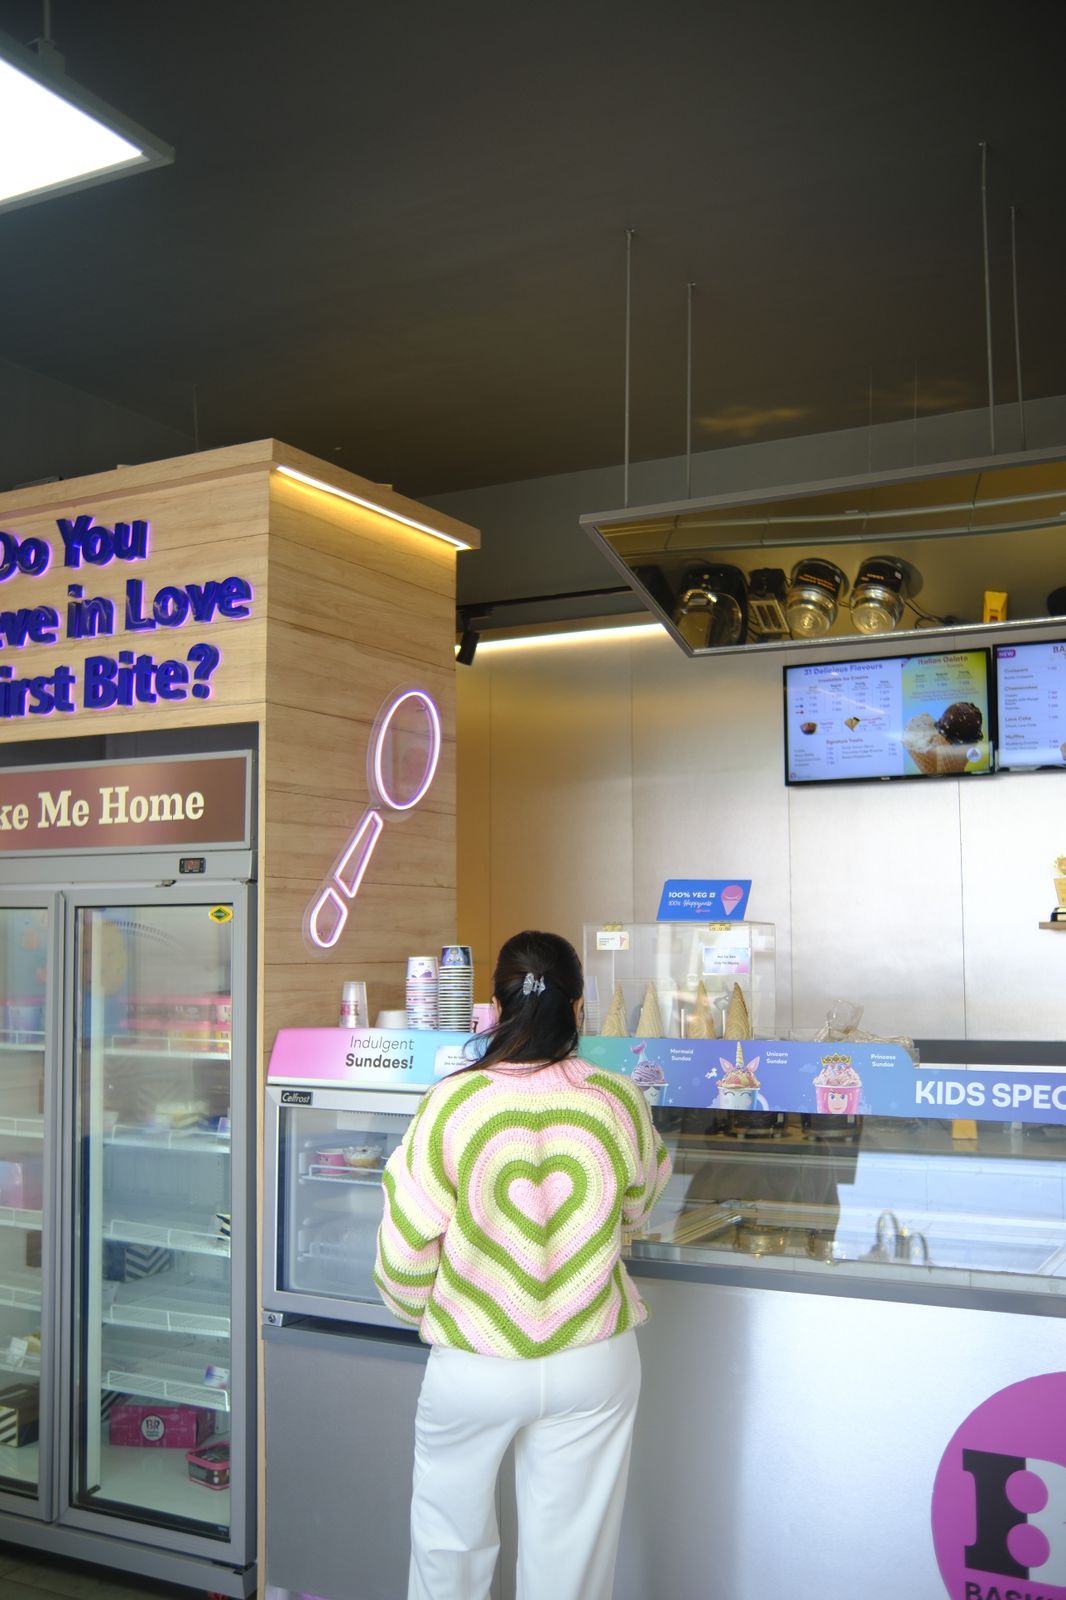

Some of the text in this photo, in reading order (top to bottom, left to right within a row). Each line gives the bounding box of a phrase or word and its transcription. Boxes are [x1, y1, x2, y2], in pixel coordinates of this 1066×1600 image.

[56, 515, 149, 568] You
[0, 577, 252, 647] ve in Love
[84, 643, 221, 710] Bite?
[37, 790, 90, 828] Me
[98, 786, 205, 825] Home
[345, 1053, 413, 1070] Sundaes!
[350, 1036, 415, 1053] Indulgent
[282, 1092, 311, 1104] Celfrost
[915, 1081, 1066, 1111] KIDS SPEC
